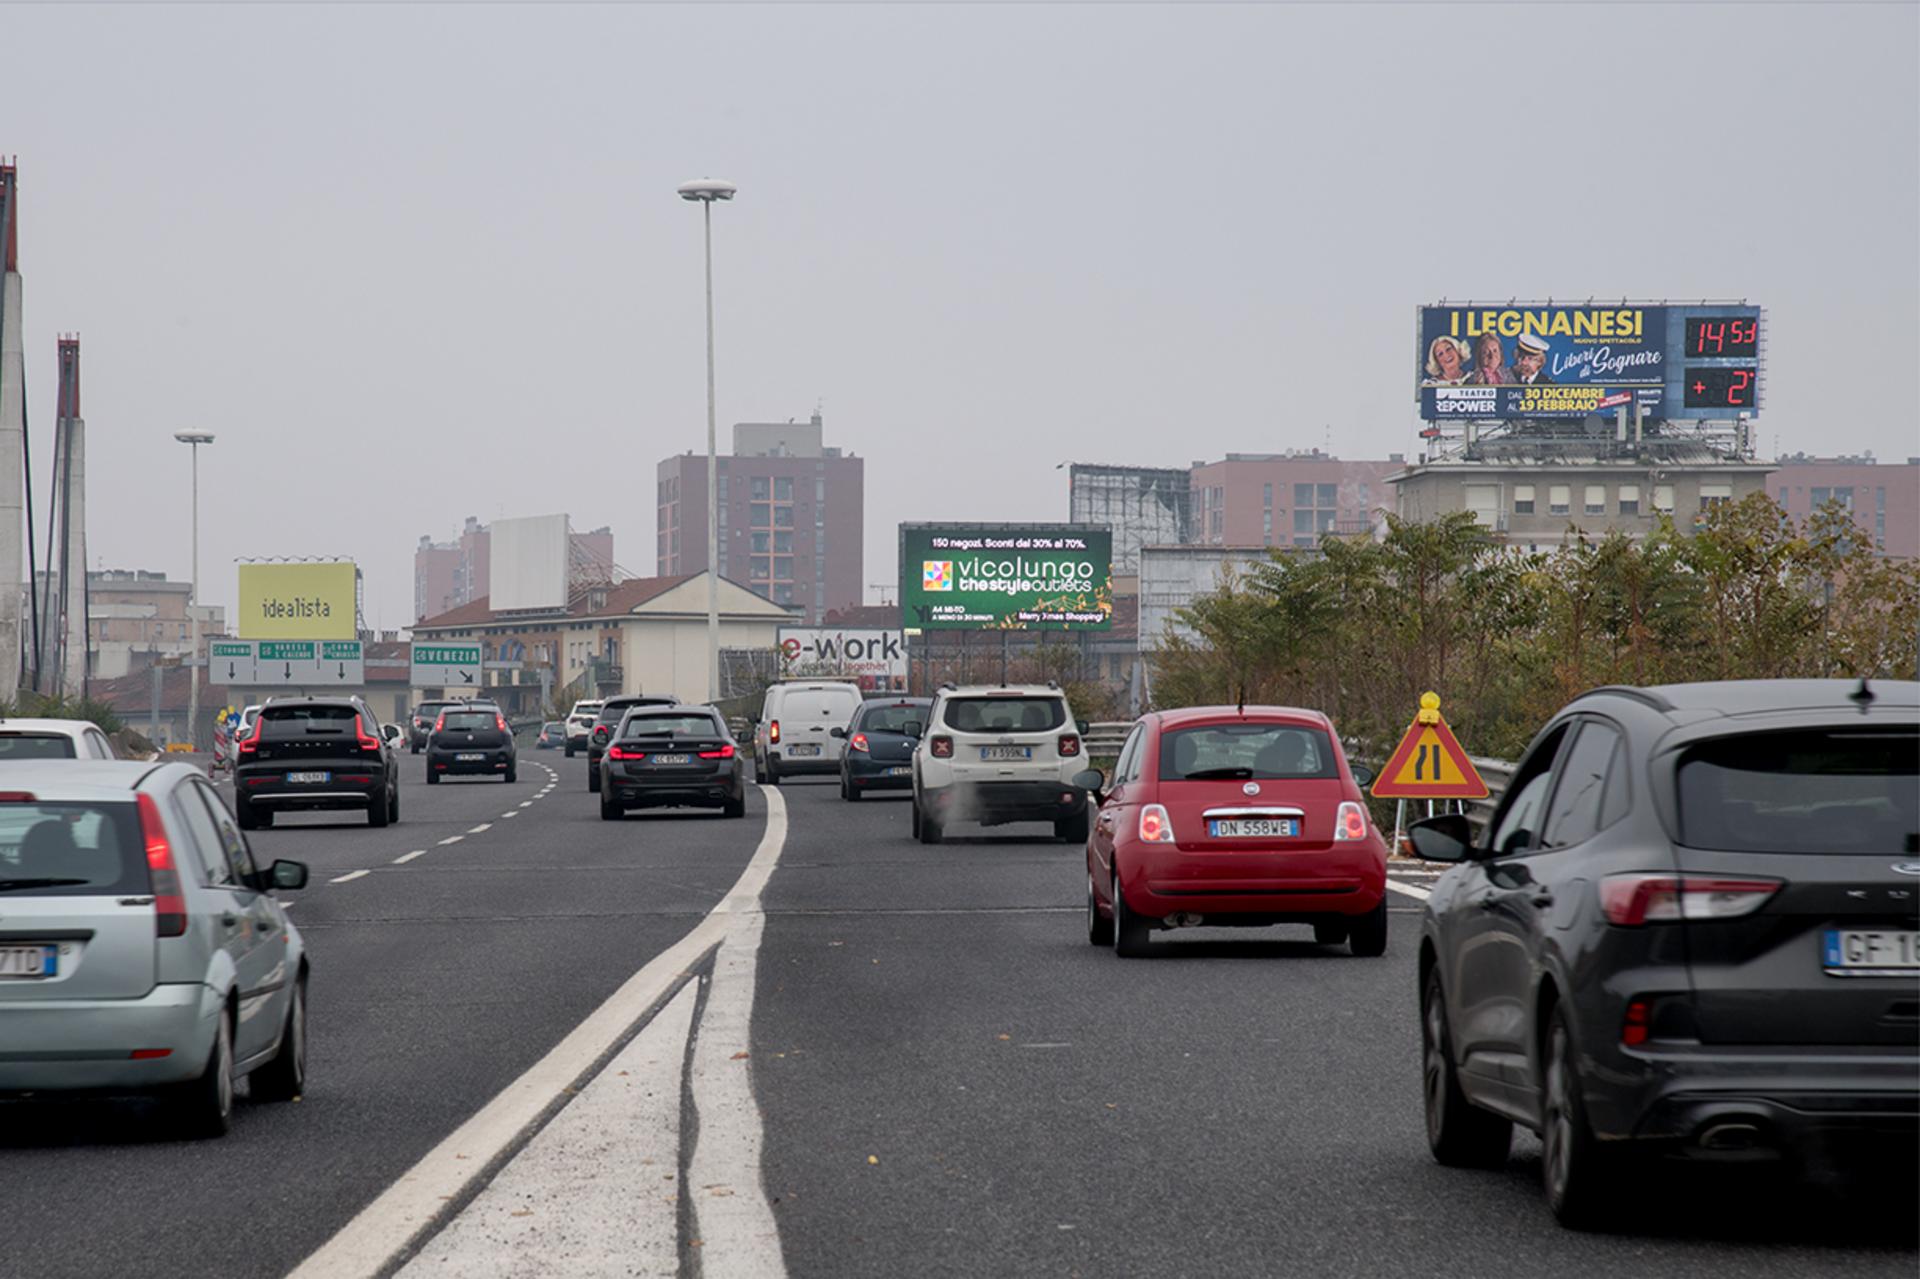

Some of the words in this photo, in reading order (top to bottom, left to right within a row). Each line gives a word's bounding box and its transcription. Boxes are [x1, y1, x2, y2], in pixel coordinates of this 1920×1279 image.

[1451, 311, 1459, 336] I
[1467, 311, 1642, 337] LEGNANESI
[1697, 323, 1726, 352] 14
[1592, 346, 1662, 375] Sognare
[1460, 389, 1495, 397] TEATRO
[1507, 391, 1522, 399] DAL
[1524, 388, 1540, 399] 30
[1543, 387, 1605, 399] DICEMBRE
[1436, 401, 1496, 412] REPOWER
[1507, 403, 1518, 411] AL
[1519, 400, 1535, 411] 19
[1537, 399, 1598, 411] FEBBRAIO
[932, 538, 949, 548] 150
[985, 538, 1014, 548] Sconti
[1016, 538, 1031, 548] dal
[1032, 538, 1052, 548] 30%
[1054, 539, 1064, 548] al
[958, 556, 1094, 581] vicolungo
[262, 597, 331, 619] idealista
[1018, 612, 1041, 622] Merry
[782, 631, 900, 660] e-work
[427, 650, 478, 661] VENEZIA
[1220, 821, 1238, 835] DN
[1243, 821, 1289, 835] 558WE
[1845, 934, 1884, 962] GF
